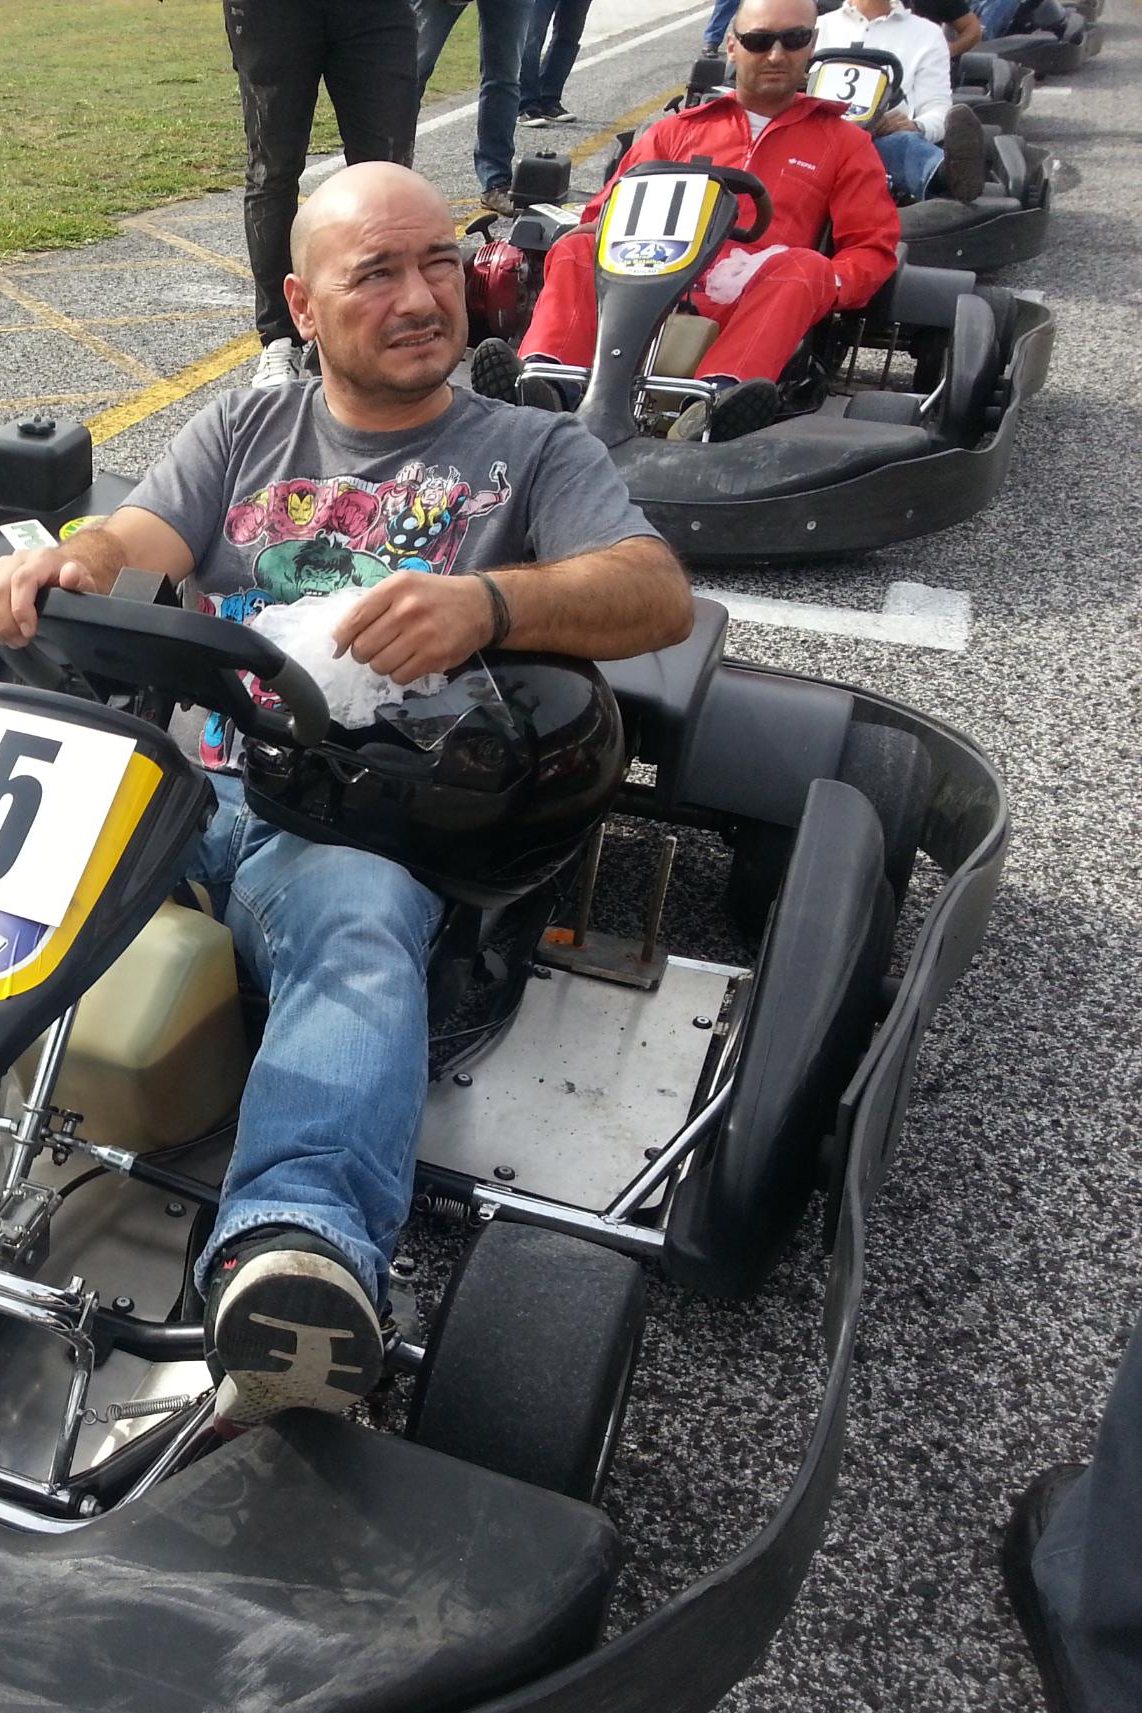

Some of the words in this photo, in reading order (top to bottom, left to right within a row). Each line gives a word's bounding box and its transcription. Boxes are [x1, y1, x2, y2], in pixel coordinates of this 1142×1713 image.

[836, 67, 860, 100] 3
[624, 181, 687, 236] 11
[624, 242, 656, 259] 24
